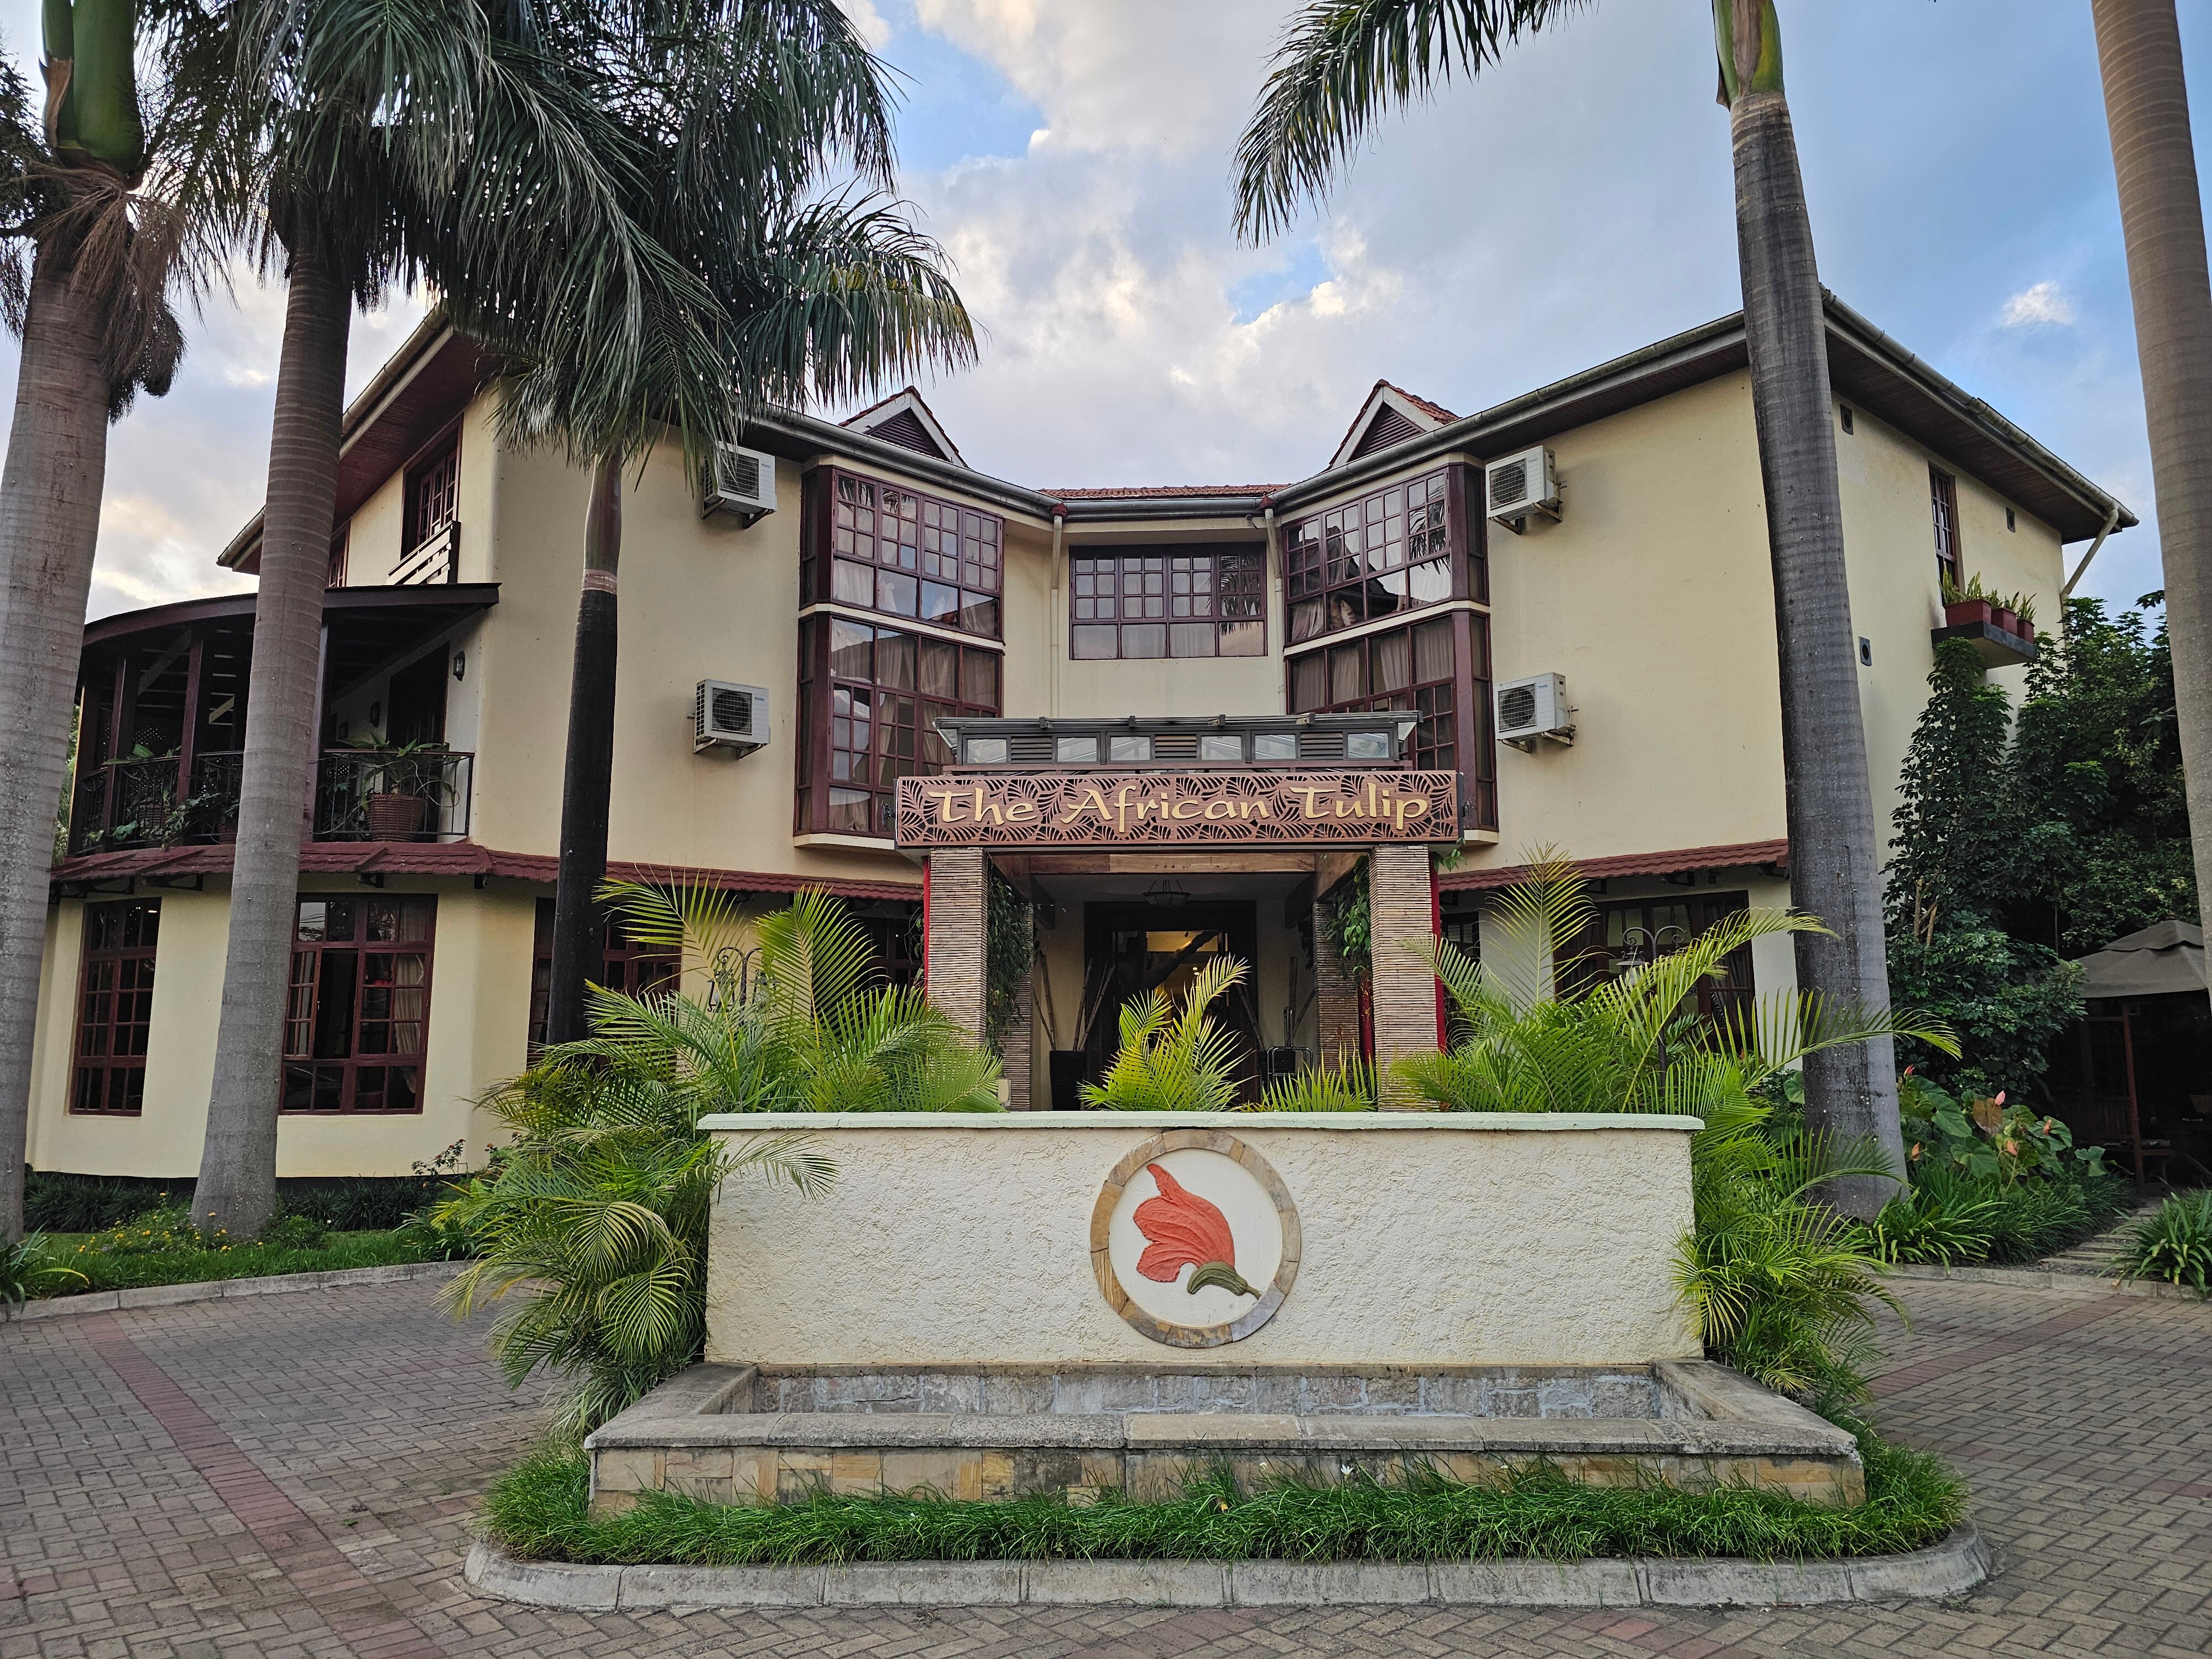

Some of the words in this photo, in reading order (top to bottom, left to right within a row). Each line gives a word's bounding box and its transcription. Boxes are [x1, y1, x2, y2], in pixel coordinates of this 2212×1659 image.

[927, 787, 1037, 825] The
[1060, 785, 1270, 833] African
[1289, 782, 1428, 830] Tulip
